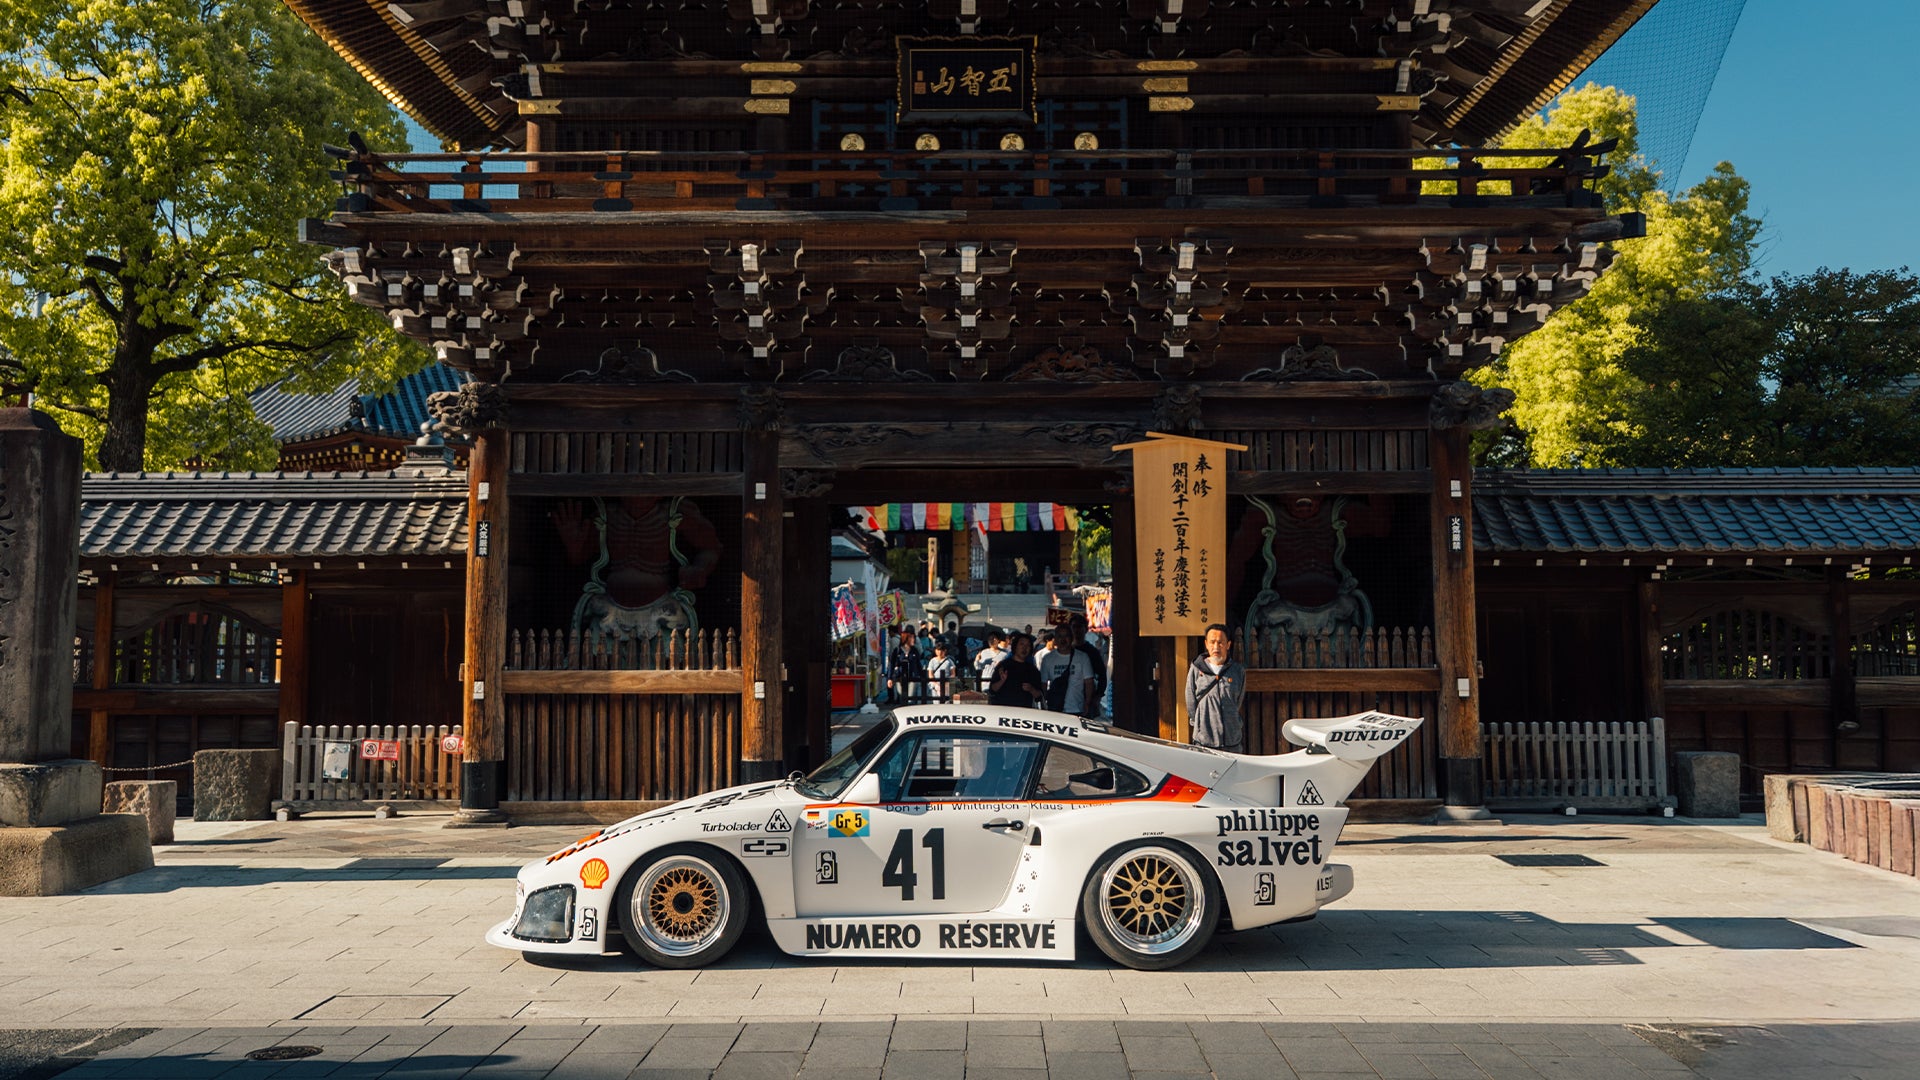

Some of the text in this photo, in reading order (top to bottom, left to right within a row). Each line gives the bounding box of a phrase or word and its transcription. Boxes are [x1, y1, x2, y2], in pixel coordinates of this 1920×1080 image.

[1193, 453, 1213, 498] 奉修
[906, 714, 986, 725] NUMERO
[1328, 729, 1406, 742] DUNLOP
[886, 803, 910, 812] Don
[926, 803, 943, 811] Bill
[1031, 803, 1063, 811] Klaus
[701, 821, 762, 832] Turbolader
[836, 813, 850, 829] Gr
[855, 813, 862, 828] 5
[1216, 808, 1320, 837] philippe
[1217, 835, 1322, 866] salvet
[882, 827, 946, 901] 41
[806, 919, 1056, 949] NUMERO RÉSERVÉ
